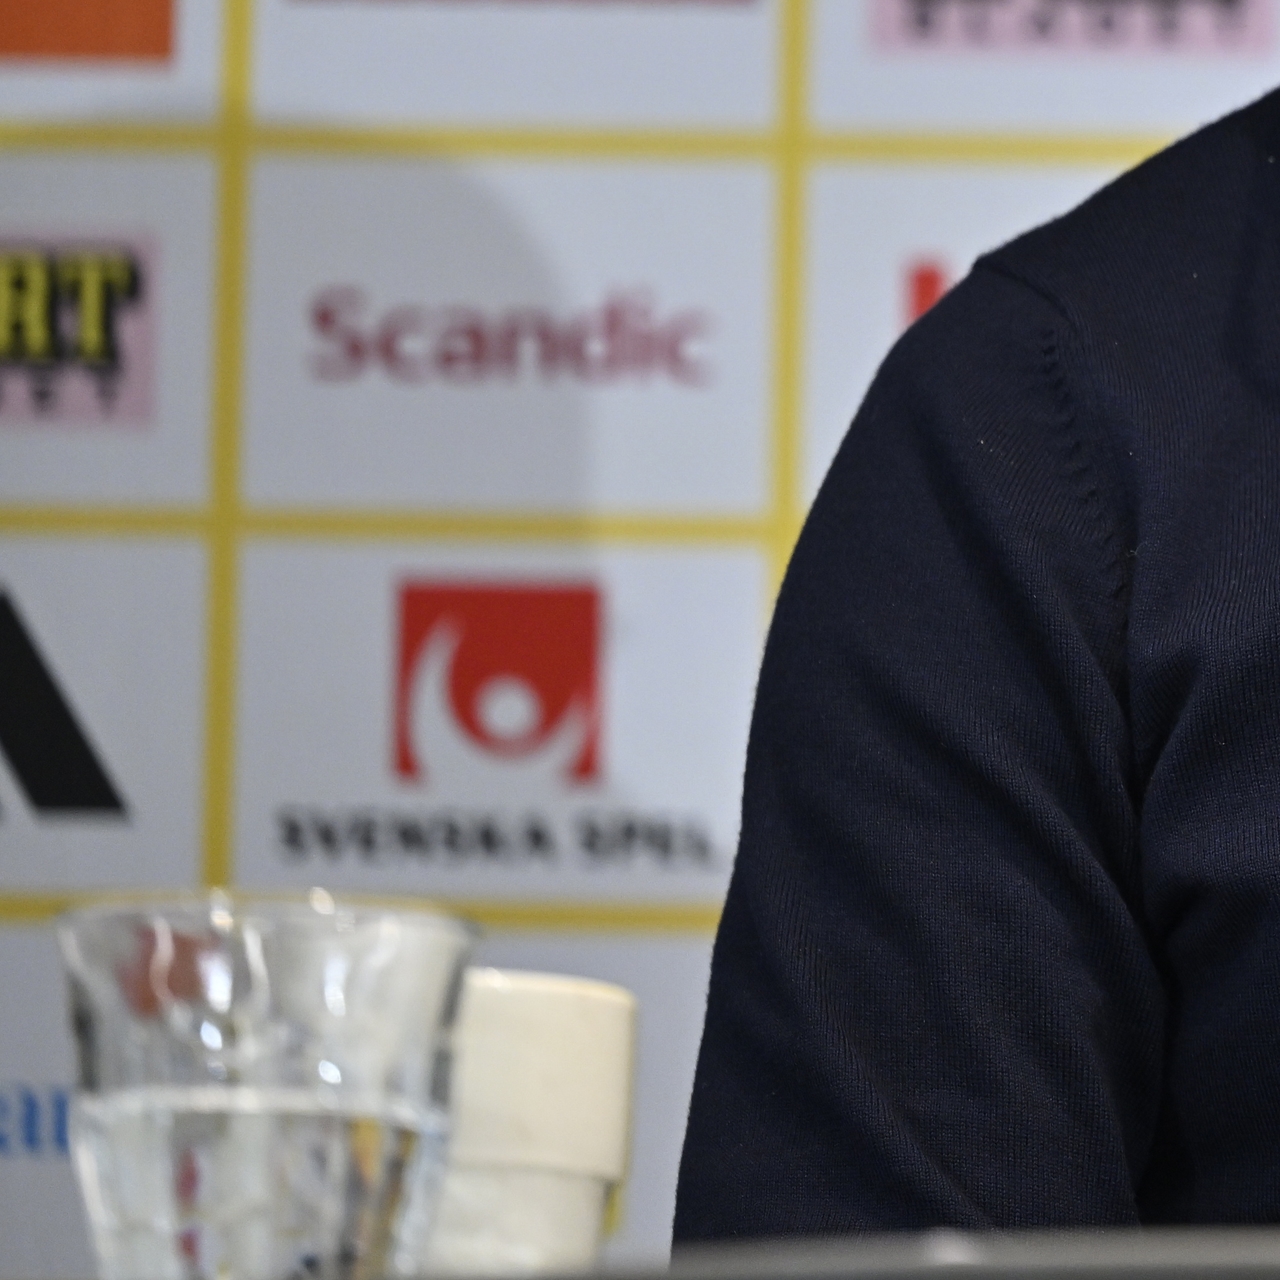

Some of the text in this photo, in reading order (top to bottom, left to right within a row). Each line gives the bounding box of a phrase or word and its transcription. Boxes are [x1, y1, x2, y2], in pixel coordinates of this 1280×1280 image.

[308, 283, 712, 386] Scandic
[277, 805, 714, 870] SVENSKA SPEL
